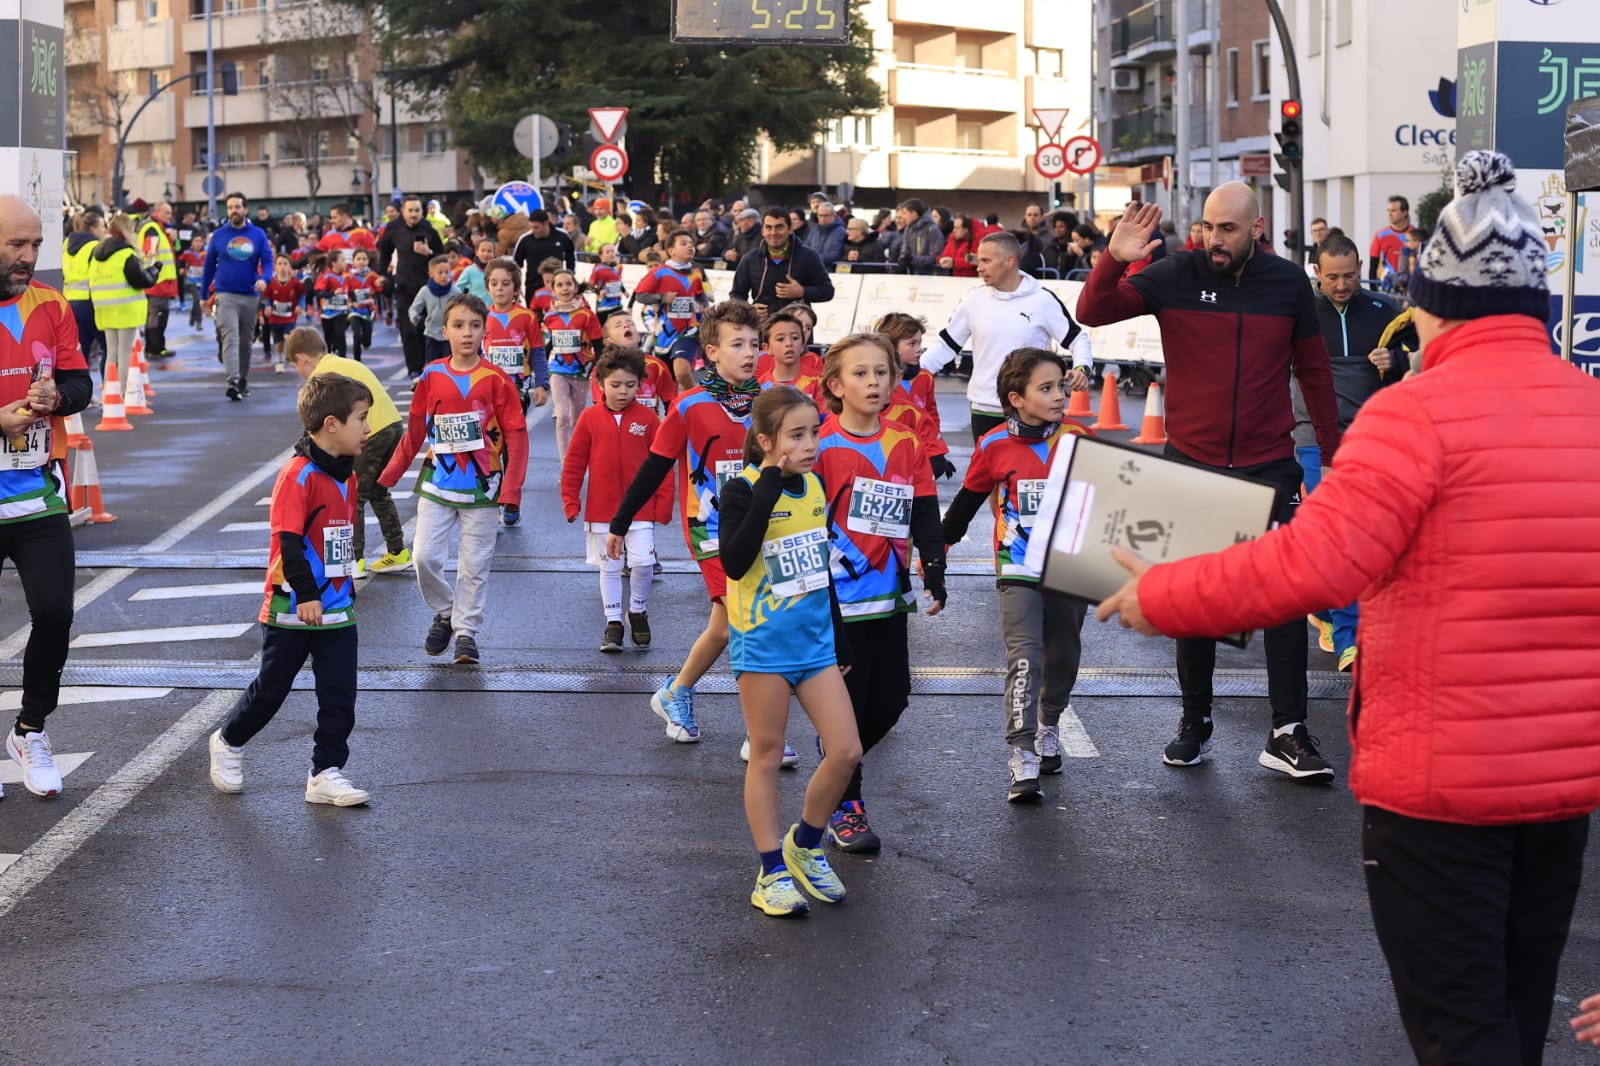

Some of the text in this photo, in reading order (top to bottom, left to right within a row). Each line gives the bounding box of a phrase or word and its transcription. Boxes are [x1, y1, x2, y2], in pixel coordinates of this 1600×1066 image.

[600, 157, 619, 169] 30
[1042, 155, 1061, 166] 30
[440, 424, 469, 440] 6363
[860, 494, 904, 520] 6324
[779, 545, 823, 576] 6136
